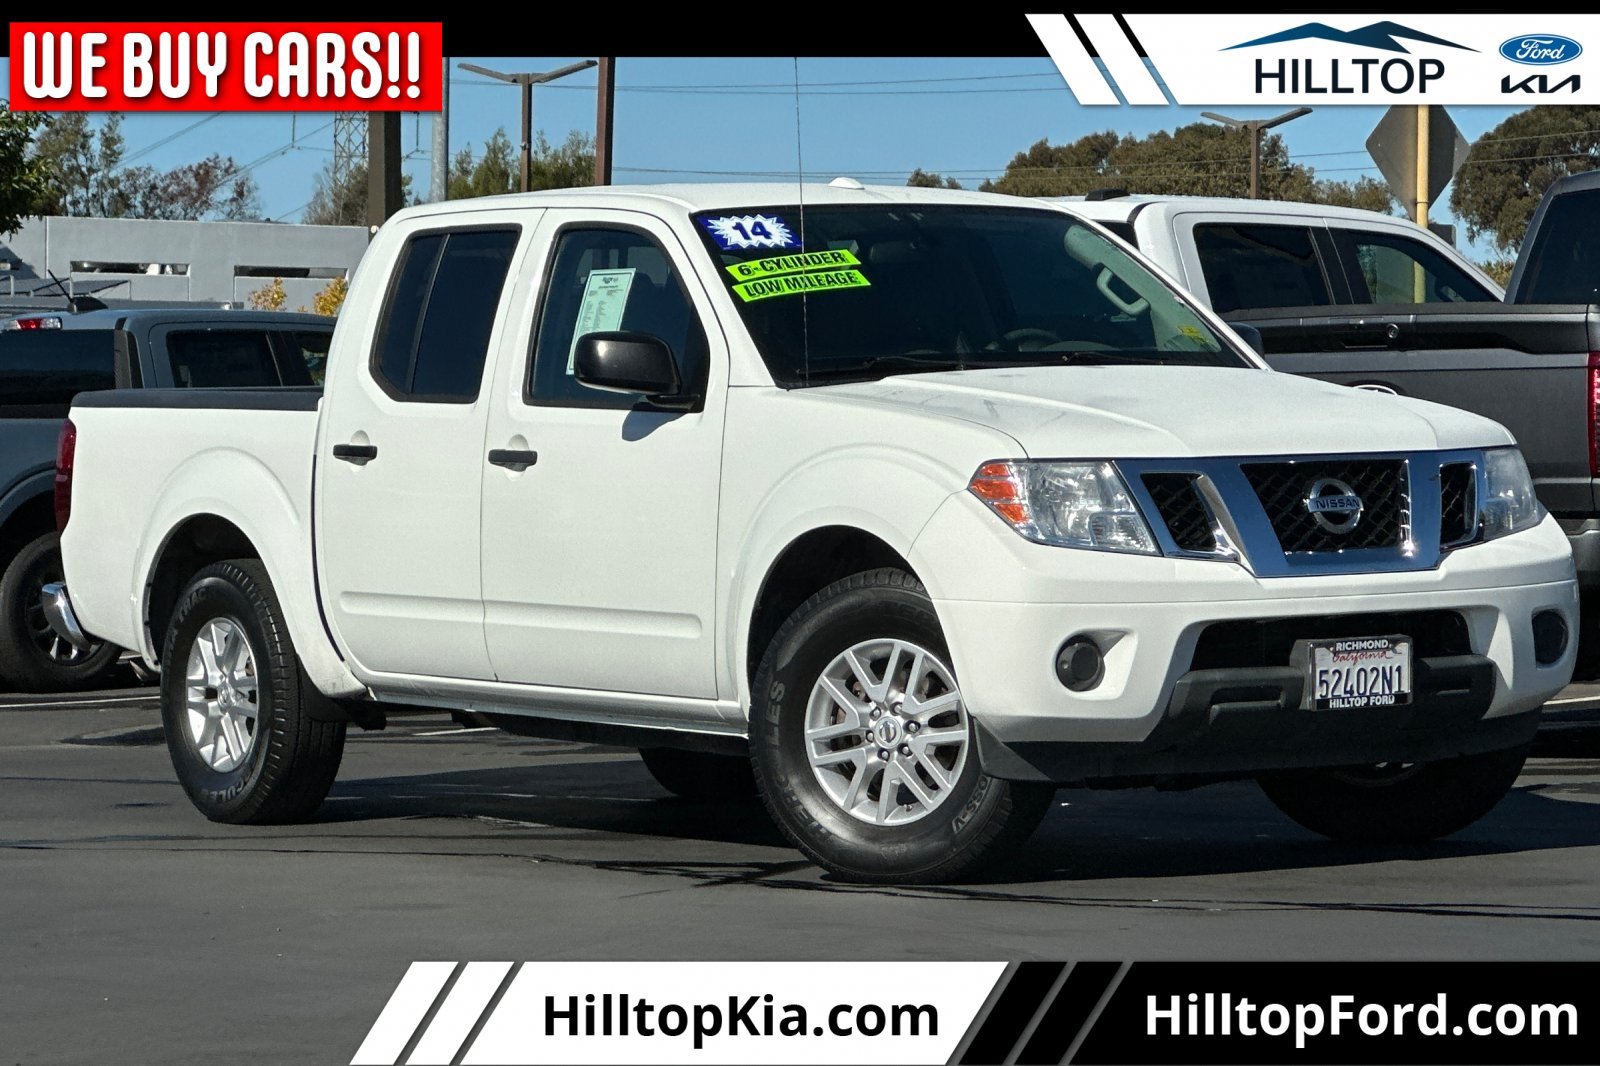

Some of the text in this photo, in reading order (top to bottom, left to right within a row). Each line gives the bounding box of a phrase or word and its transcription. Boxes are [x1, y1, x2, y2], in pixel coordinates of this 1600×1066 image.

[732, 221, 772, 240] 14
[737, 251, 846, 276] 6-CYLINDER
[744, 272, 860, 297] LOW MILEAGE
[1316, 498, 1360, 509] NISSAN
[1335, 640, 1389, 653] RICHMOND
[1332, 650, 1393, 666] California
[1318, 664, 1405, 698] 52402N1
[1329, 694, 1396, 709] HILLTOP FORD
